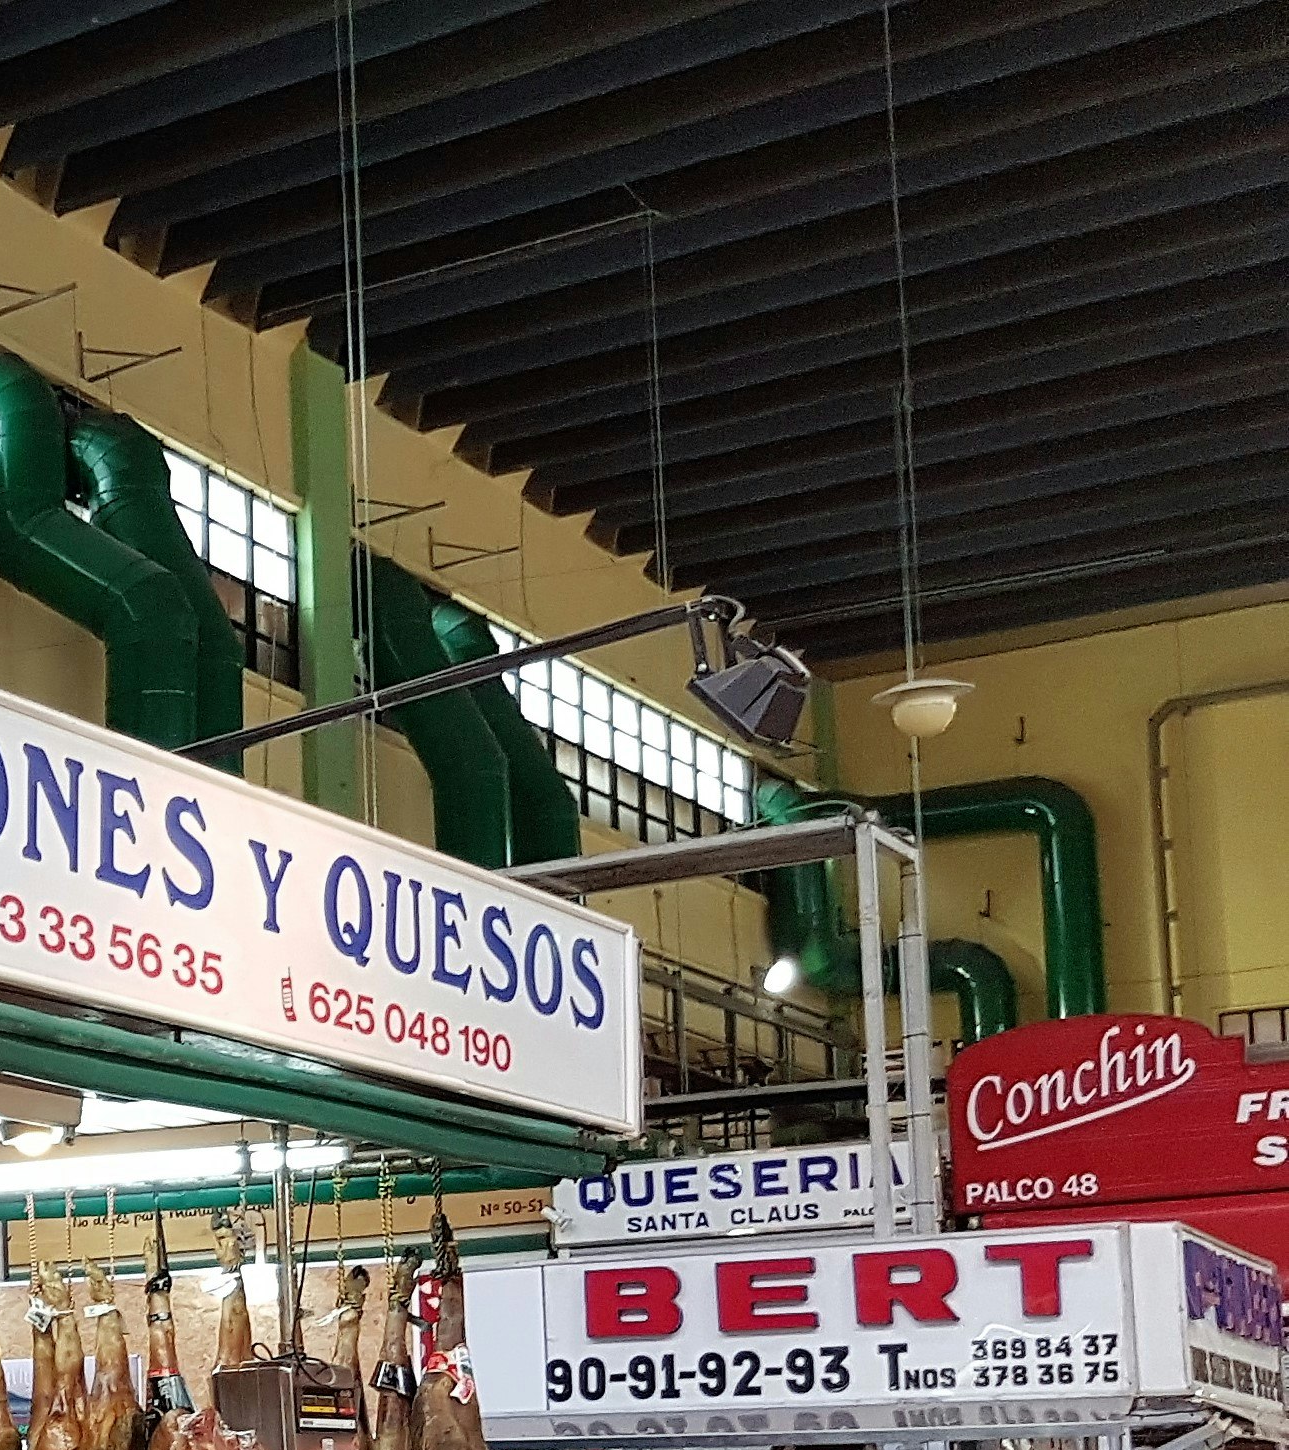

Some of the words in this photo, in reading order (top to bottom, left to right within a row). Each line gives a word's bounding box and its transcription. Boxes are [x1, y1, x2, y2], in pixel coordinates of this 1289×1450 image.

[38, 904, 96, 961] 33
[108, 923, 165, 979] 56
[172, 941, 225, 997] 35
[247, 839, 294, 935] Y
[322, 854, 606, 1031] QUESOS
[308, 981, 374, 1037] 625
[385, 1001, 452, 1056] 048
[458, 1023, 512, 1073] 190
[966, 1023, 1195, 1142] Conchin
[627, 1211, 710, 1234] SANTA
[730, 1203, 819, 1225] CLAUS
[965, 1177, 1055, 1205] PALCO
[1062, 1172, 1099, 1197] 48
[584, 1238, 1094, 1340] BERT
[546, 1346, 849, 1403] 90-91-92-93
[970, 1338, 1028, 1362] 369
[1034, 1336, 1073, 1358] 84
[1082, 1334, 1119, 1356] 37
[973, 1365, 1029, 1388] 378
[1037, 1363, 1075, 1385] 36
[1084, 1361, 1120, 1384] 75
